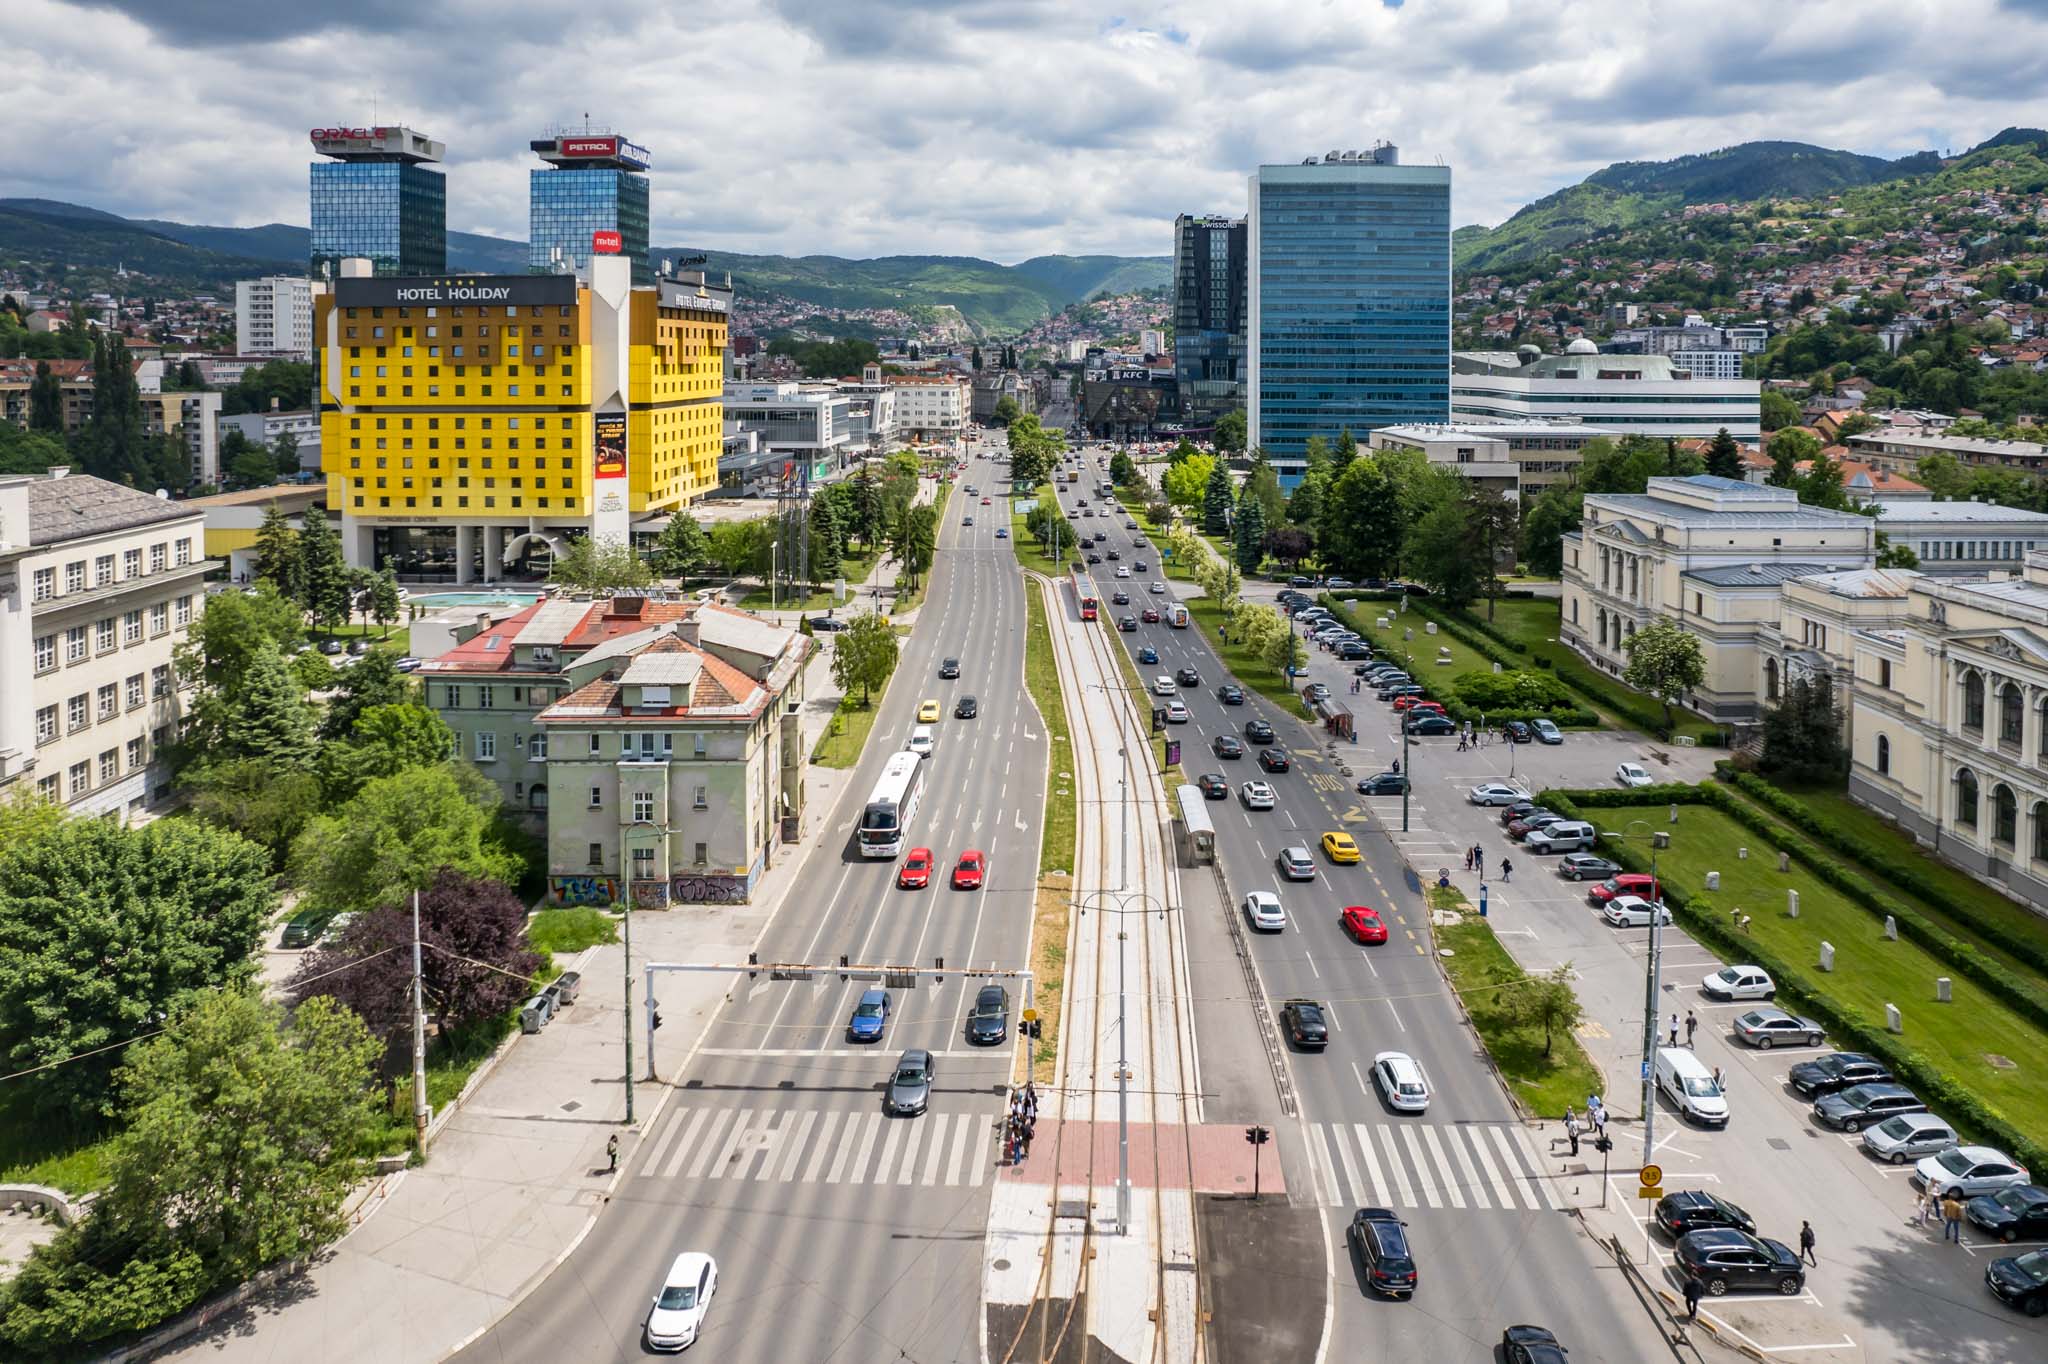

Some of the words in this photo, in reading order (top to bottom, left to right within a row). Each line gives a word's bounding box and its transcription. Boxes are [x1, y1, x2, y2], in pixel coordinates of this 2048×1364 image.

[310, 128, 387, 140] ORACLE
[569, 143, 610, 151] PETROL
[397, 288, 442, 300] HOTEL
[448, 287, 510, 300] HOLIDAY
[675, 294, 692, 307] HOTEL
[1122, 371, 1143, 379] KFC
[1167, 423, 1183, 431] SCC
[1312, 774, 1345, 791] BUS
